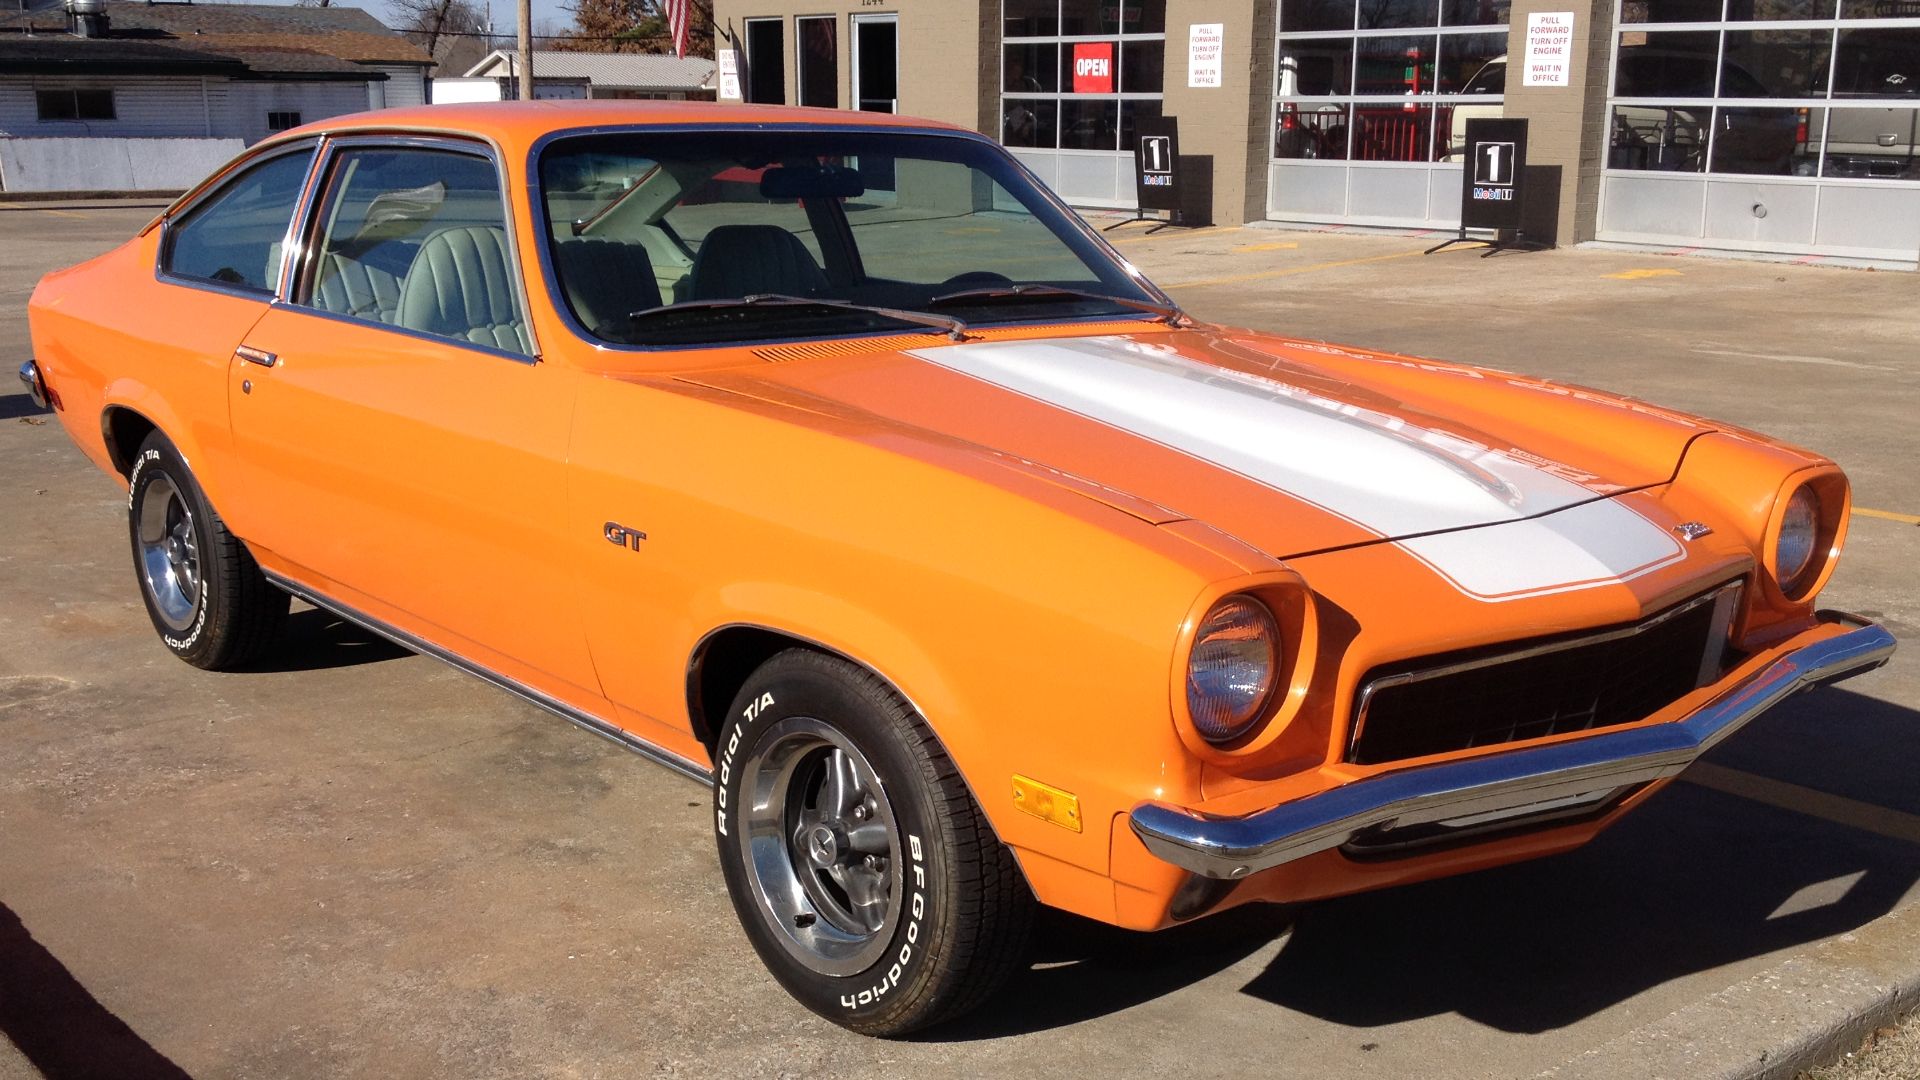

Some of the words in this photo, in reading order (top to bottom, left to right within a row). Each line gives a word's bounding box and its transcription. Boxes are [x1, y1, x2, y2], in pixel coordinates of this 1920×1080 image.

[1540, 16, 1560, 24] PULL
[1530, 26, 1570, 34] FORWARD
[1530, 37, 1551, 45] TURN
[1552, 37, 1568, 45] OFF
[1533, 47, 1562, 55] ENGINE
[1076, 58, 1109, 77] OPEN
[1532, 64, 1551, 72] WAIT
[1553, 64, 1562, 72] IN
[1532, 74, 1560, 82] OFFICE
[1149, 139, 1160, 170] 1
[1486, 145, 1500, 182] 1
[1143, 175, 1164, 186] Mobil
[1473, 188, 1501, 200] Mobil
[128, 455, 145, 510] Radial
[145, 449, 160, 460] T/A
[603, 521, 647, 552] GT
[164, 579, 208, 651] BFGoodrich
[718, 724, 743, 836] Radial
[743, 691, 775, 721] T/A
[840, 834, 927, 1010] BFGoodrich
